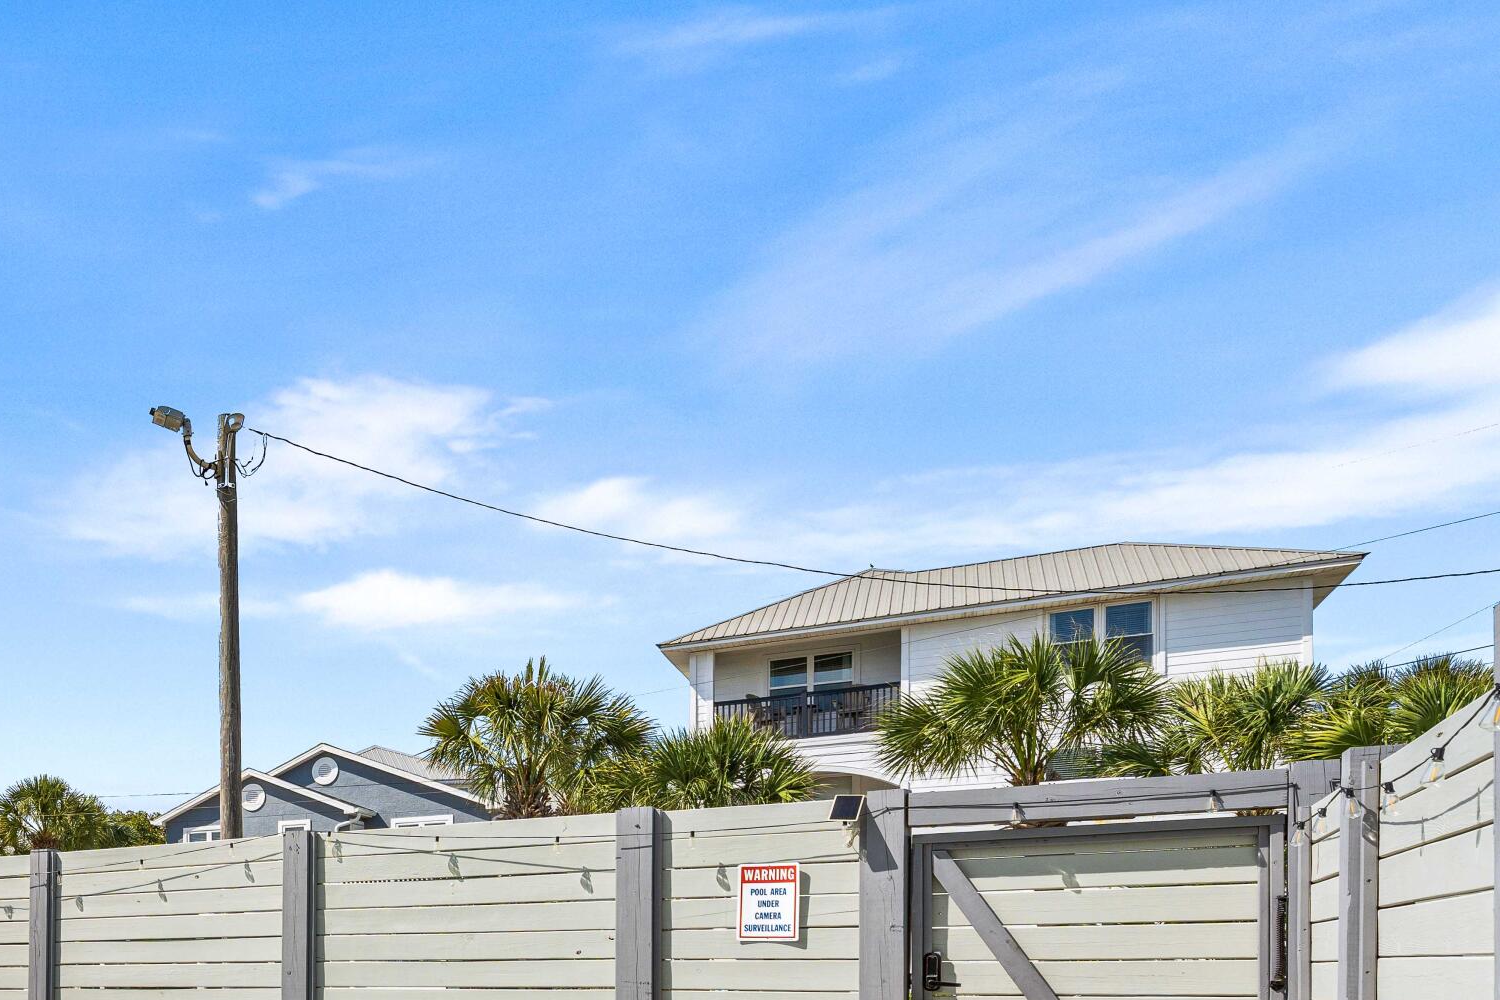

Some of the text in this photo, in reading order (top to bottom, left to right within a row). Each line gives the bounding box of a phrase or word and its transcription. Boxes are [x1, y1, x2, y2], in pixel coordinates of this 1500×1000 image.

[743, 868, 795, 881] WARNING
[750, 888, 787, 896] POOL AREA
[754, 912, 782, 920] CAMERA
[744, 924, 791, 932] SURVEILLANCE
